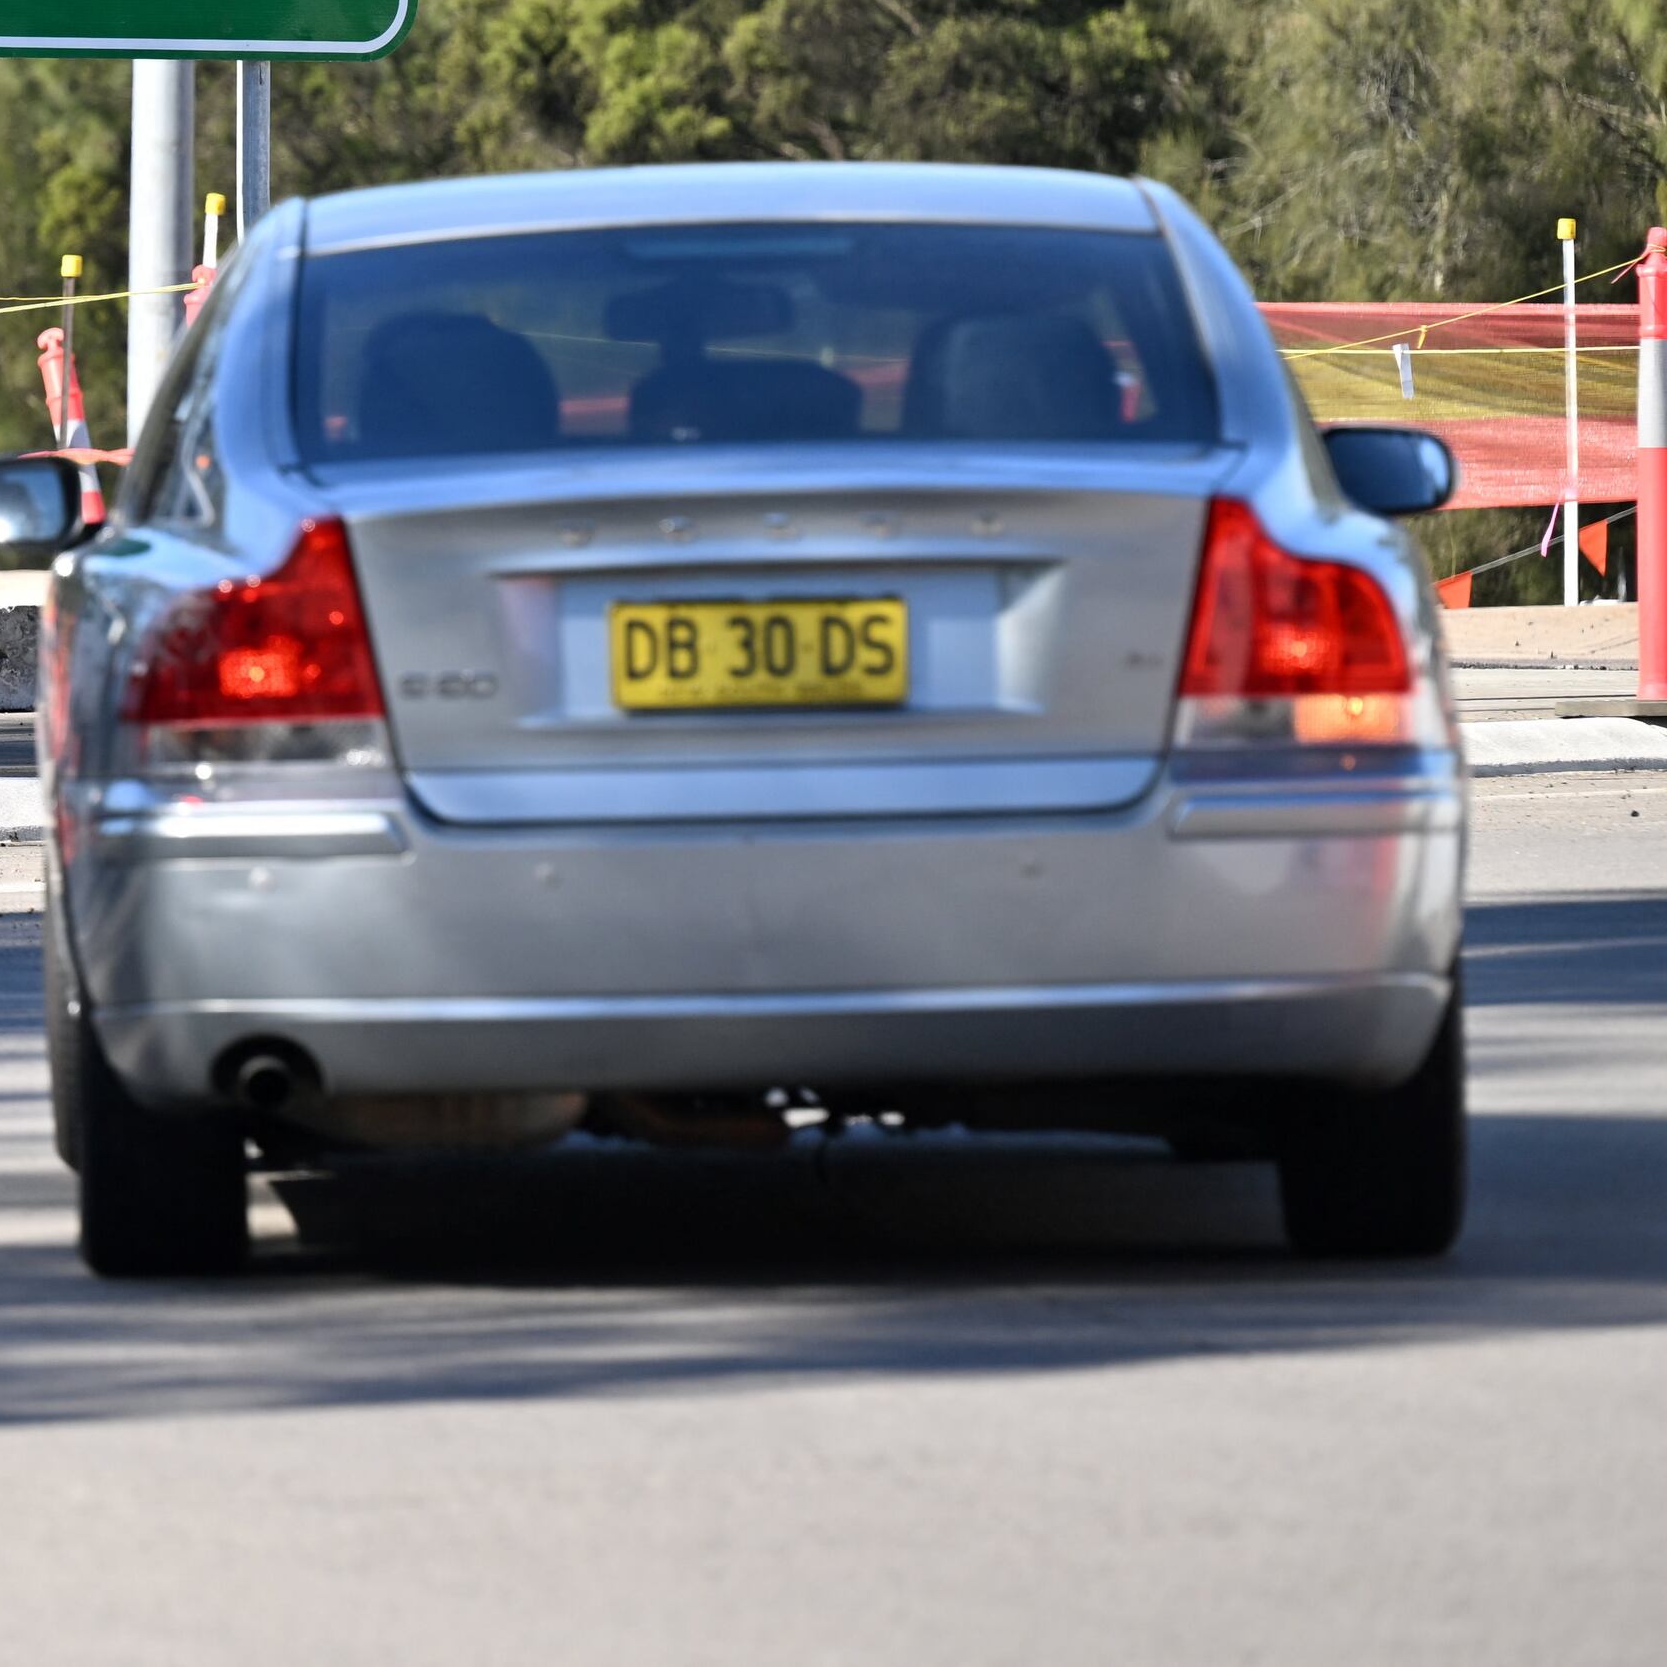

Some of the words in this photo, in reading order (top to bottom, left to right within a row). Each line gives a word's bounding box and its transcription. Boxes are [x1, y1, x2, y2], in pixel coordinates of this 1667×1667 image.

[626, 617, 698, 680] DB
[728, 614, 796, 679] 30
[820, 615, 894, 679] DS
